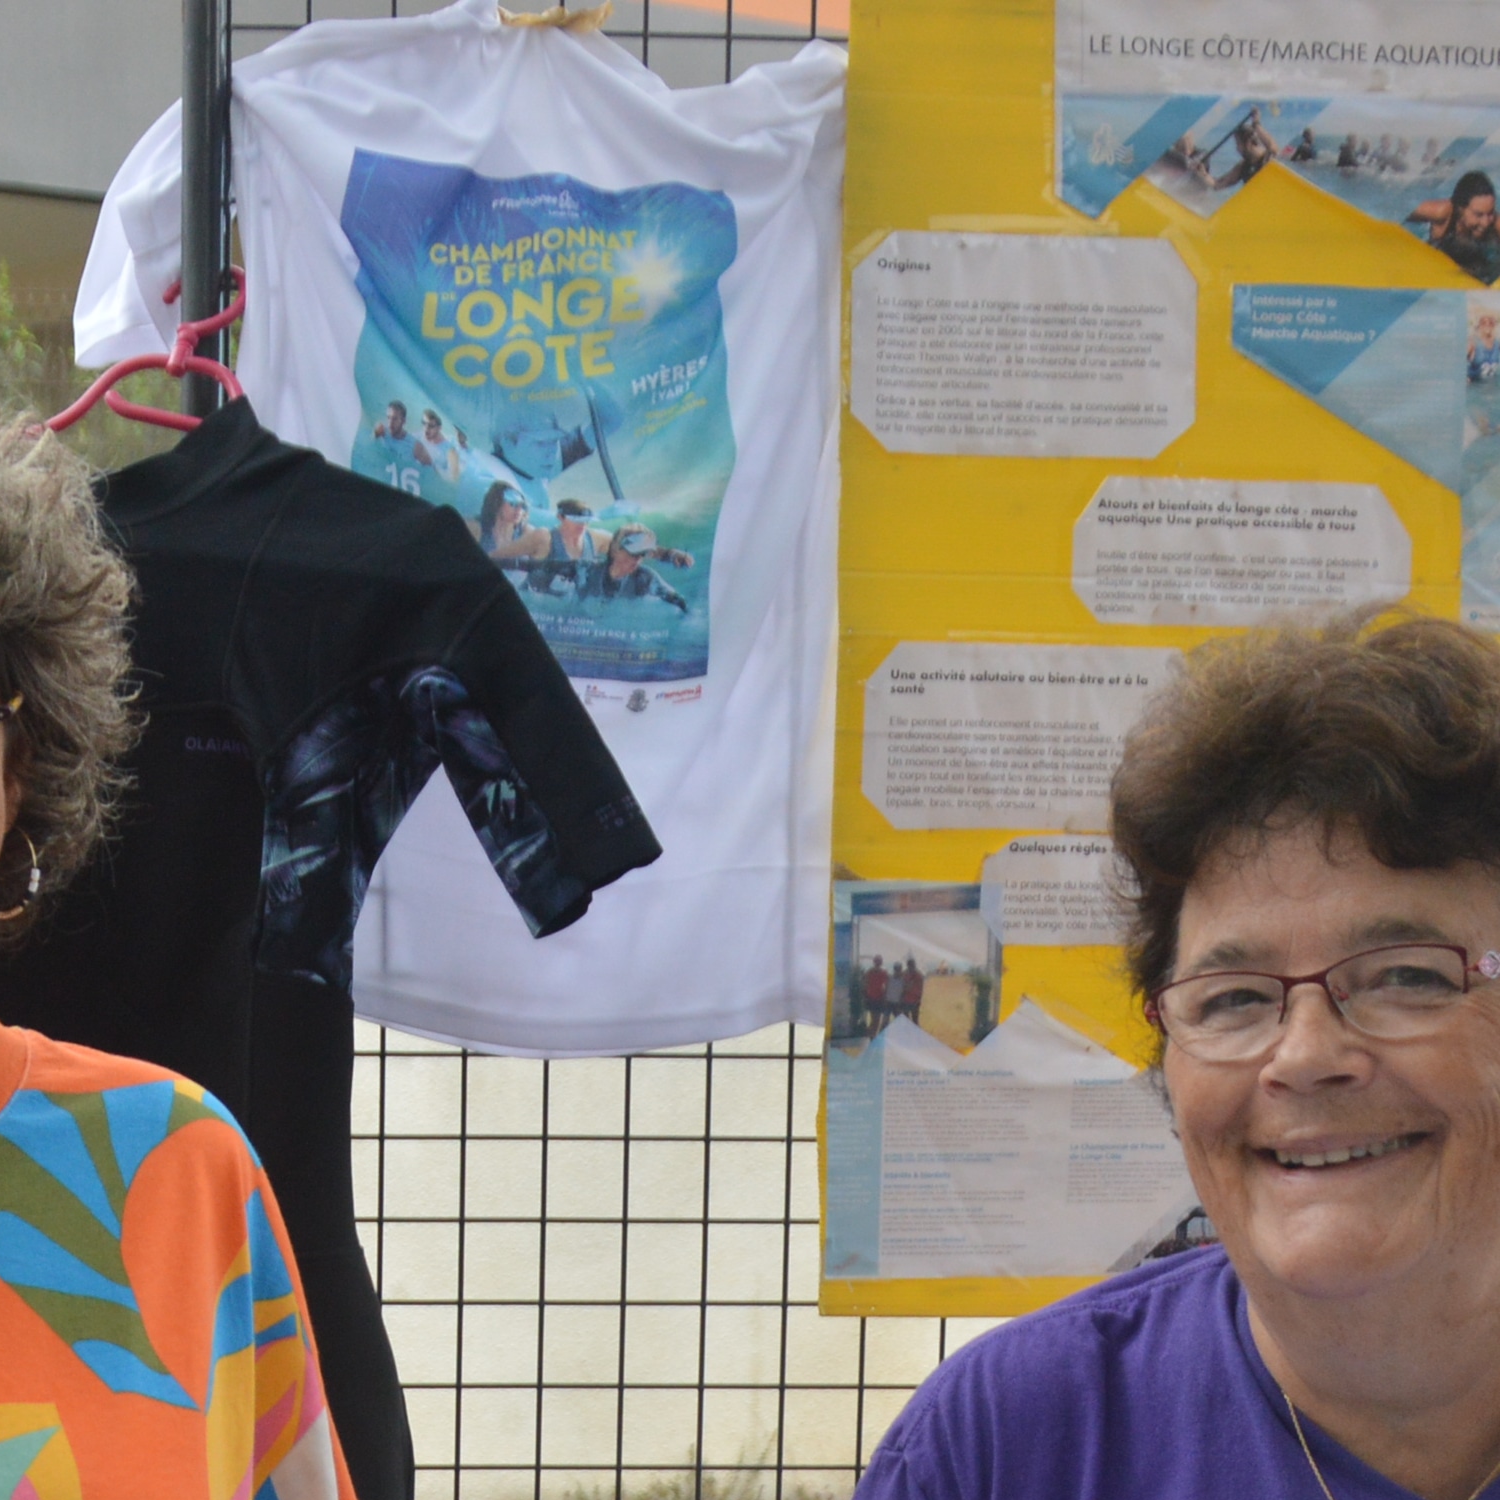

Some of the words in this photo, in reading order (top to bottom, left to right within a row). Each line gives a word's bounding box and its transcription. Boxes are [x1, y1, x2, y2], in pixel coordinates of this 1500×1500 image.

[1089, 36, 1112, 55] LE
[1120, 37, 1195, 59] LONGE
[1202, 34, 1367, 65] CÔTE/MARCHE
[429, 226, 638, 266] CHAMPIONNAT
[455, 264, 492, 286] DE
[502, 251, 615, 284] FRANCE
[877, 258, 931, 272] Origines
[421, 277, 647, 341] LONGE
[1305, 297, 1325, 309] par
[1252, 310, 1293, 326] Longe
[1296, 311, 1327, 324] Côte
[1252, 327, 1298, 340] Marche
[1302, 329, 1365, 343] Aquatique
[443, 323, 616, 388] CÔTE
[385, 462, 421, 497] 16
[1098, 513, 1162, 528] aquatique
[1166, 515, 1192, 526] Une
[1195, 516, 1248, 530] pratique
[1252, 517, 1313, 529] accessible
[1316, 519, 1326, 529] à
[1328, 519, 1356, 530] tous
[890, 669, 916, 680] Une
[919, 670, 966, 681] activité
[969, 671, 1025, 682] salutaire
[1028, 675, 1044, 683] au
[1047, 672, 1104, 684] bien-être
[1108, 674, 1120, 684] et
[1123, 674, 1132, 684] à
[1135, 674, 1148, 685] la
[890, 684, 925, 695] santé
[1009, 842, 1066, 855] Quelques
[1069, 842, 1107, 856] règles
